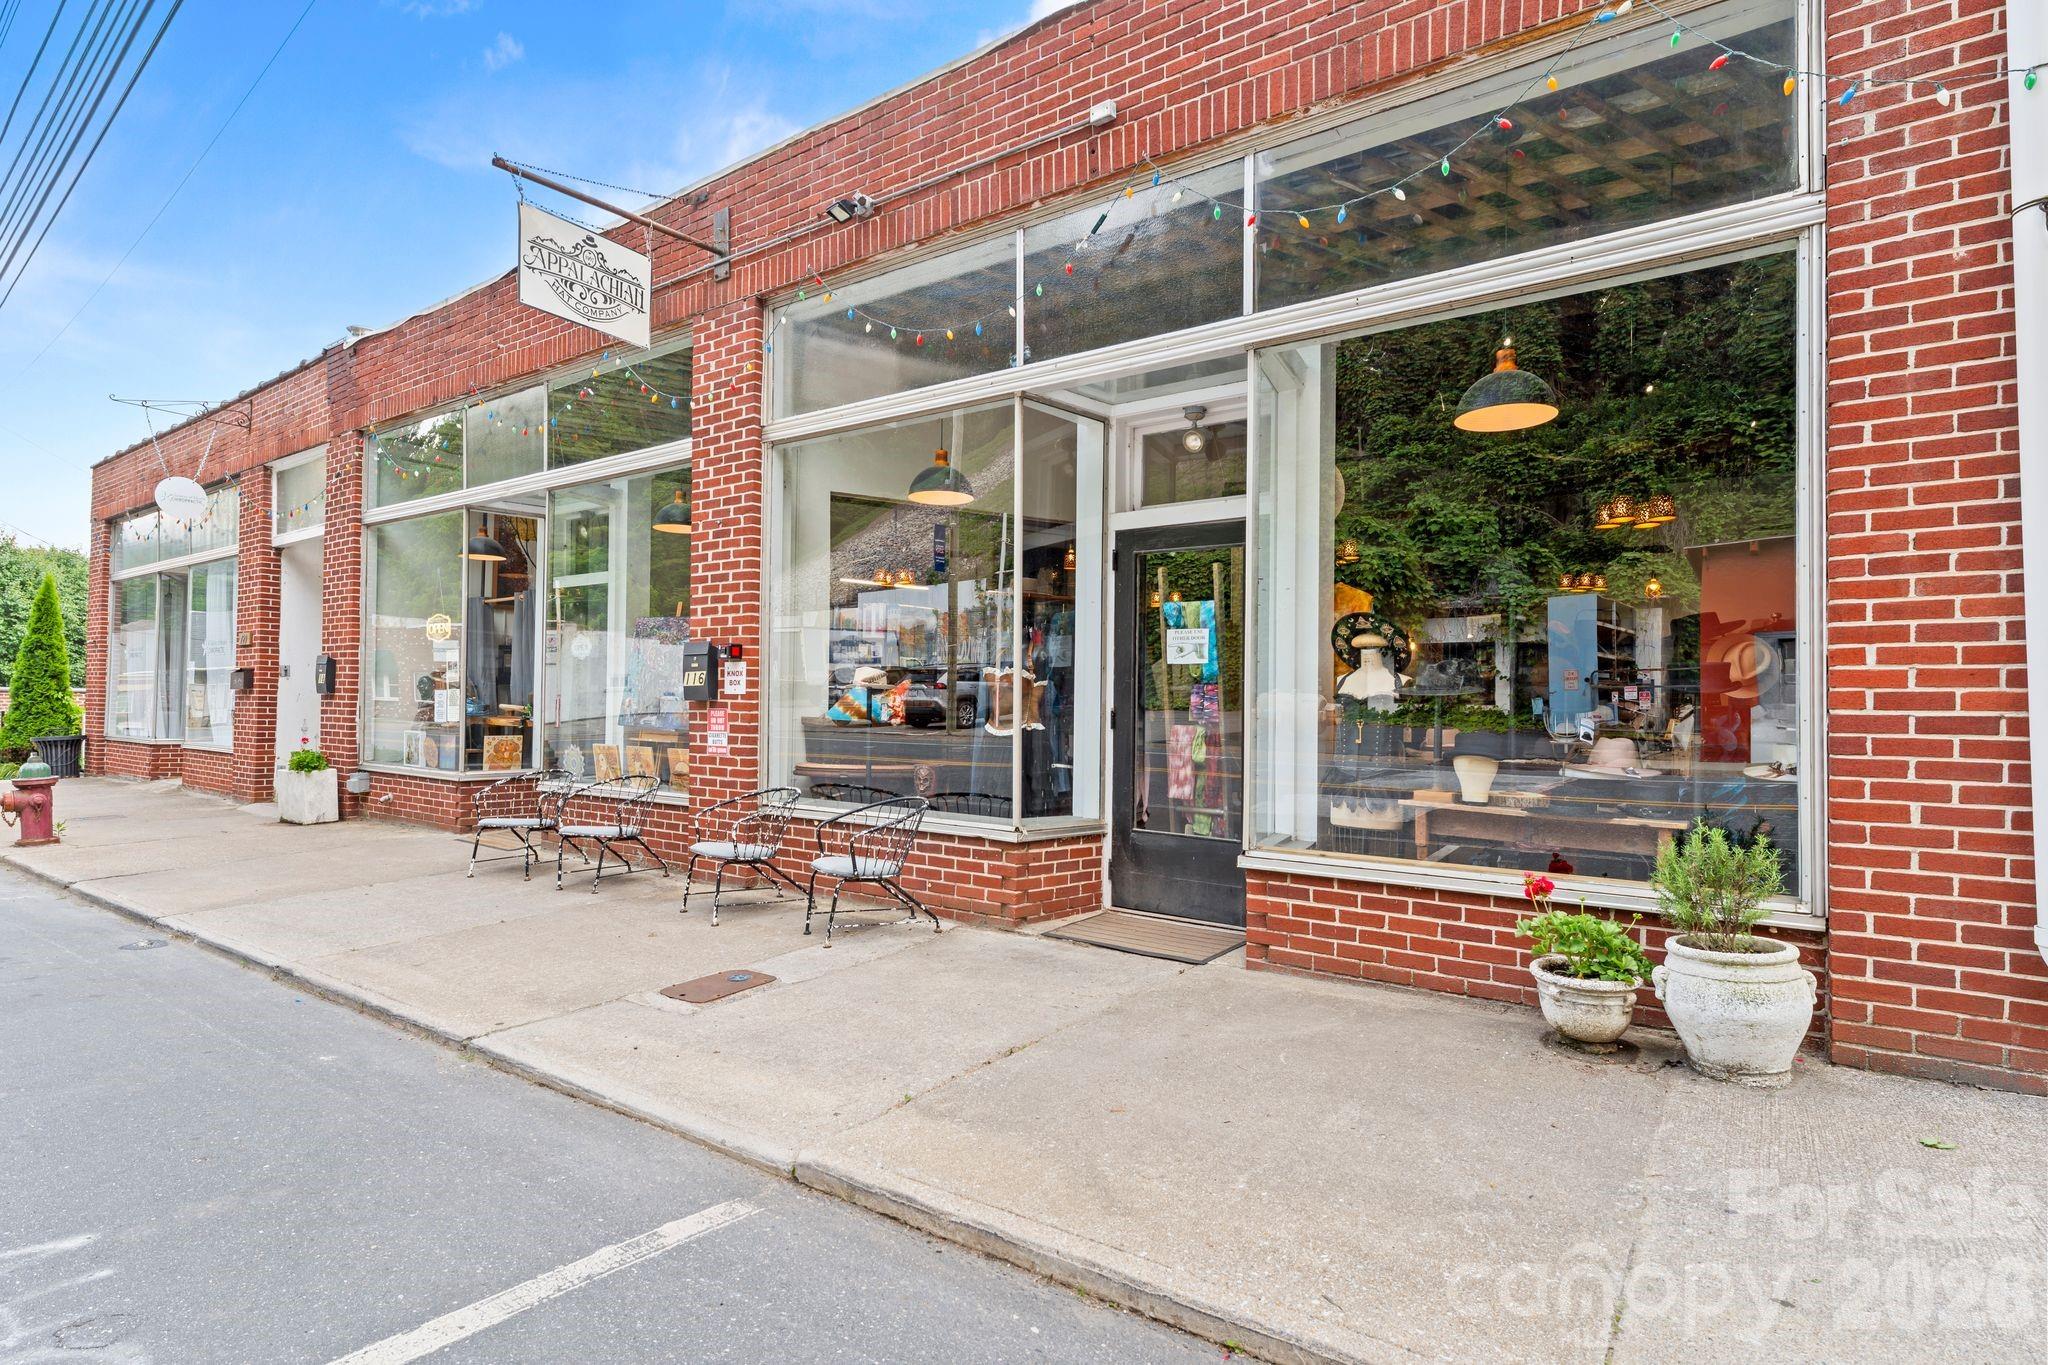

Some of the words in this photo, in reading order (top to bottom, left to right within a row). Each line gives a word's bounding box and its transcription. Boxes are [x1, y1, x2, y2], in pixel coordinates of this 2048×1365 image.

[523, 245, 644, 309] APPALACHIAN
[551, 281, 572, 303] HAT
[575, 301, 624, 318] COMPANY
[429, 623, 448, 634] OPEN
[686, 672, 705, 685] 116
